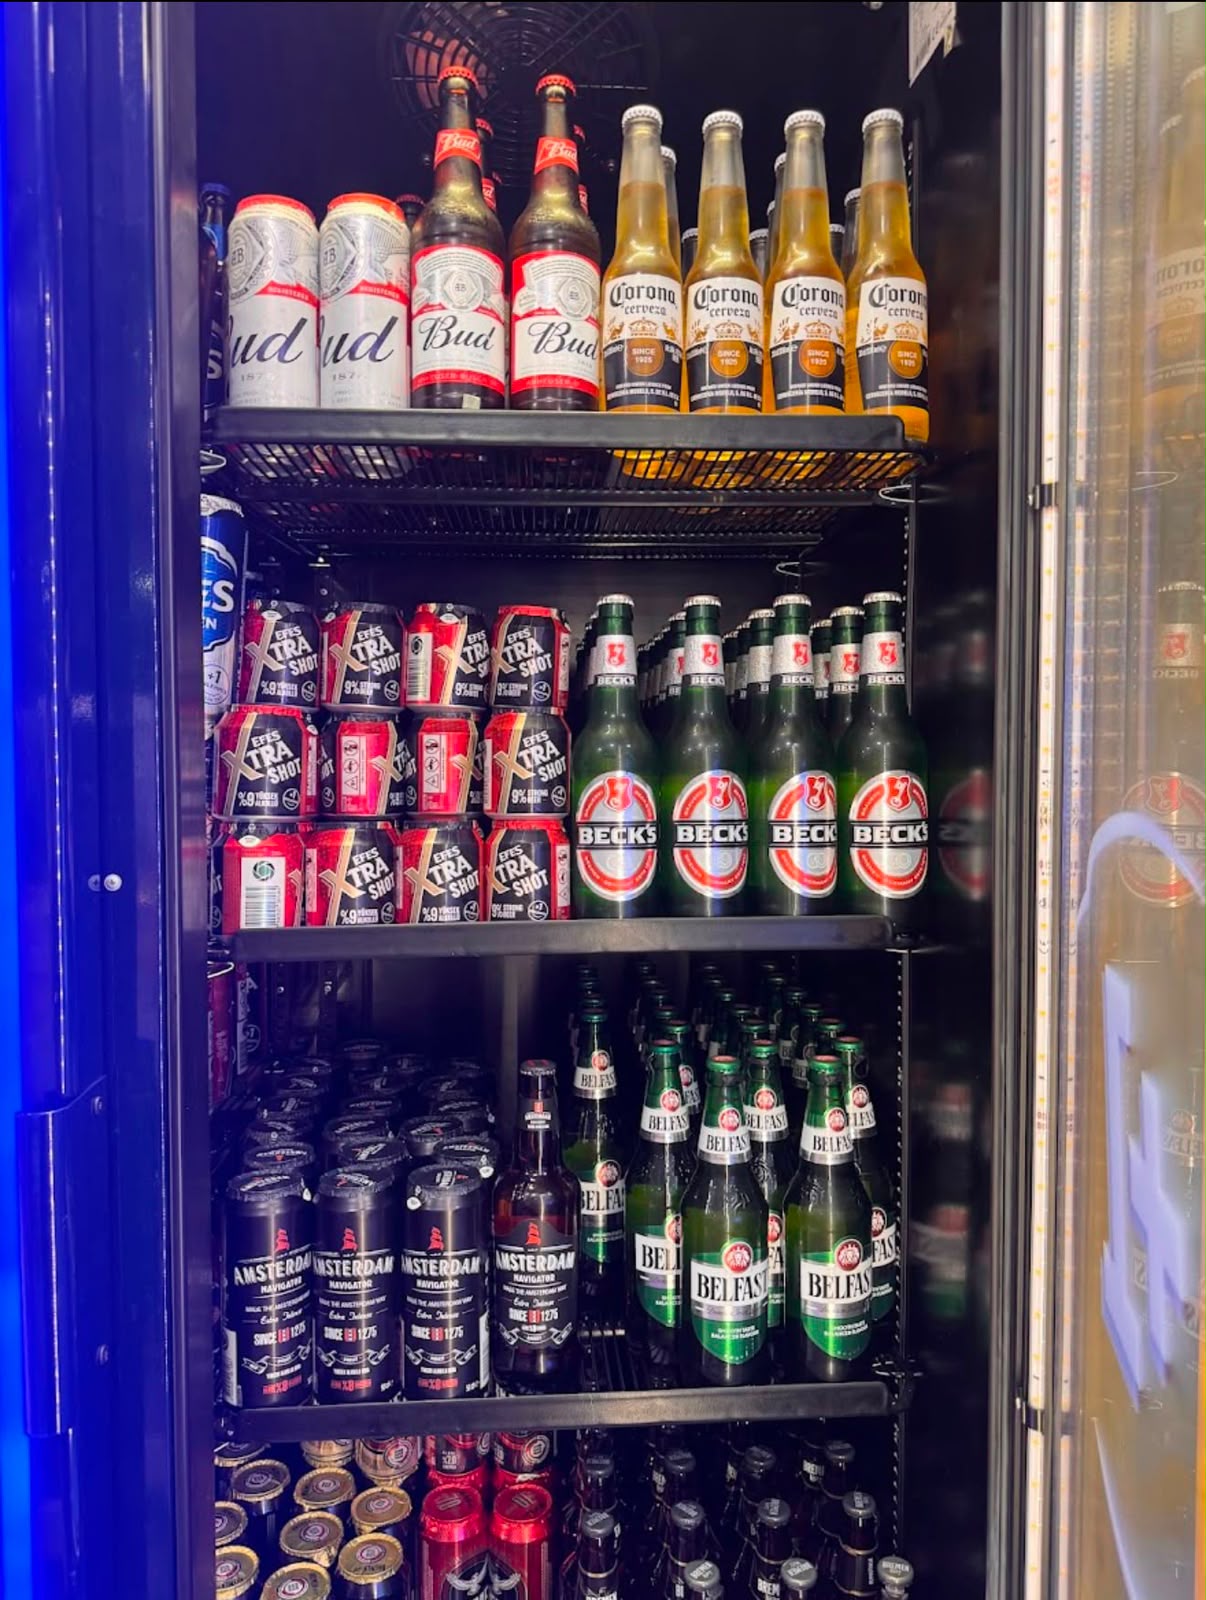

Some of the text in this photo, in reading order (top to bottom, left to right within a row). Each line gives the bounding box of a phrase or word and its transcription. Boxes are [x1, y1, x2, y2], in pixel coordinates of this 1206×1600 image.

[440, 132, 480, 151] Bud
[545, 140, 577, 160] Bud
[609, 281, 676, 308] Corona
[693, 284, 759, 311] Corona
[868, 283, 927, 309] Coron
[624, 304, 667, 316] cerveza
[709, 307, 751, 318] cerveza
[799, 307, 838, 319] cerveza
[229, 315, 308, 368] ud
[320, 315, 399, 368] ud
[418, 315, 496, 351] Bud
[528, 321, 599, 360] Bud
[275, 625, 302, 641] EFES
[357, 625, 384, 641] EFES
[507, 628, 531, 644] EFES
[288, 653, 319, 677] SHOT
[370, 652, 400, 676] SHOT
[519, 653, 552, 678] SHOT
[251, 730, 282, 748] EFES
[523, 730, 549, 748] EFES
[267, 758, 301, 784] SHOT
[538, 756, 567, 783] SHOT
[578, 824, 656, 845] BECK'S
[853, 821, 928, 843] BECK'S
[352, 847, 380, 866] EFES
[433, 845, 461, 864] EFES
[499, 844, 524, 862] EFES
[368, 872, 395, 900] SHOT
[449, 870, 479, 898] SHOT
[512, 869, 549, 898] SHOT
[581, 1073, 615, 1088] BELFAS
[649, 1114, 687, 1131] BELFAS
[706, 1134, 747, 1151] BELFAS
[234, 1251, 312, 1285] AMSTERDA
[313, 1256, 394, 1277] AMSTERDAM
[401, 1255, 481, 1276] AMSTERDAM
[495, 1250, 576, 1272] AMSTERDAM
[260, 1276, 303, 1294] NAVIGATOR
[329, 1279, 373, 1290] NAVIGATOR
[416, 1279, 459, 1289] NAVIGATOR
[513, 1273, 555, 1283] NAVIGATOR
[809, 1272, 872, 1299] BELFAS
[757, 1578, 780, 1596] BREM
